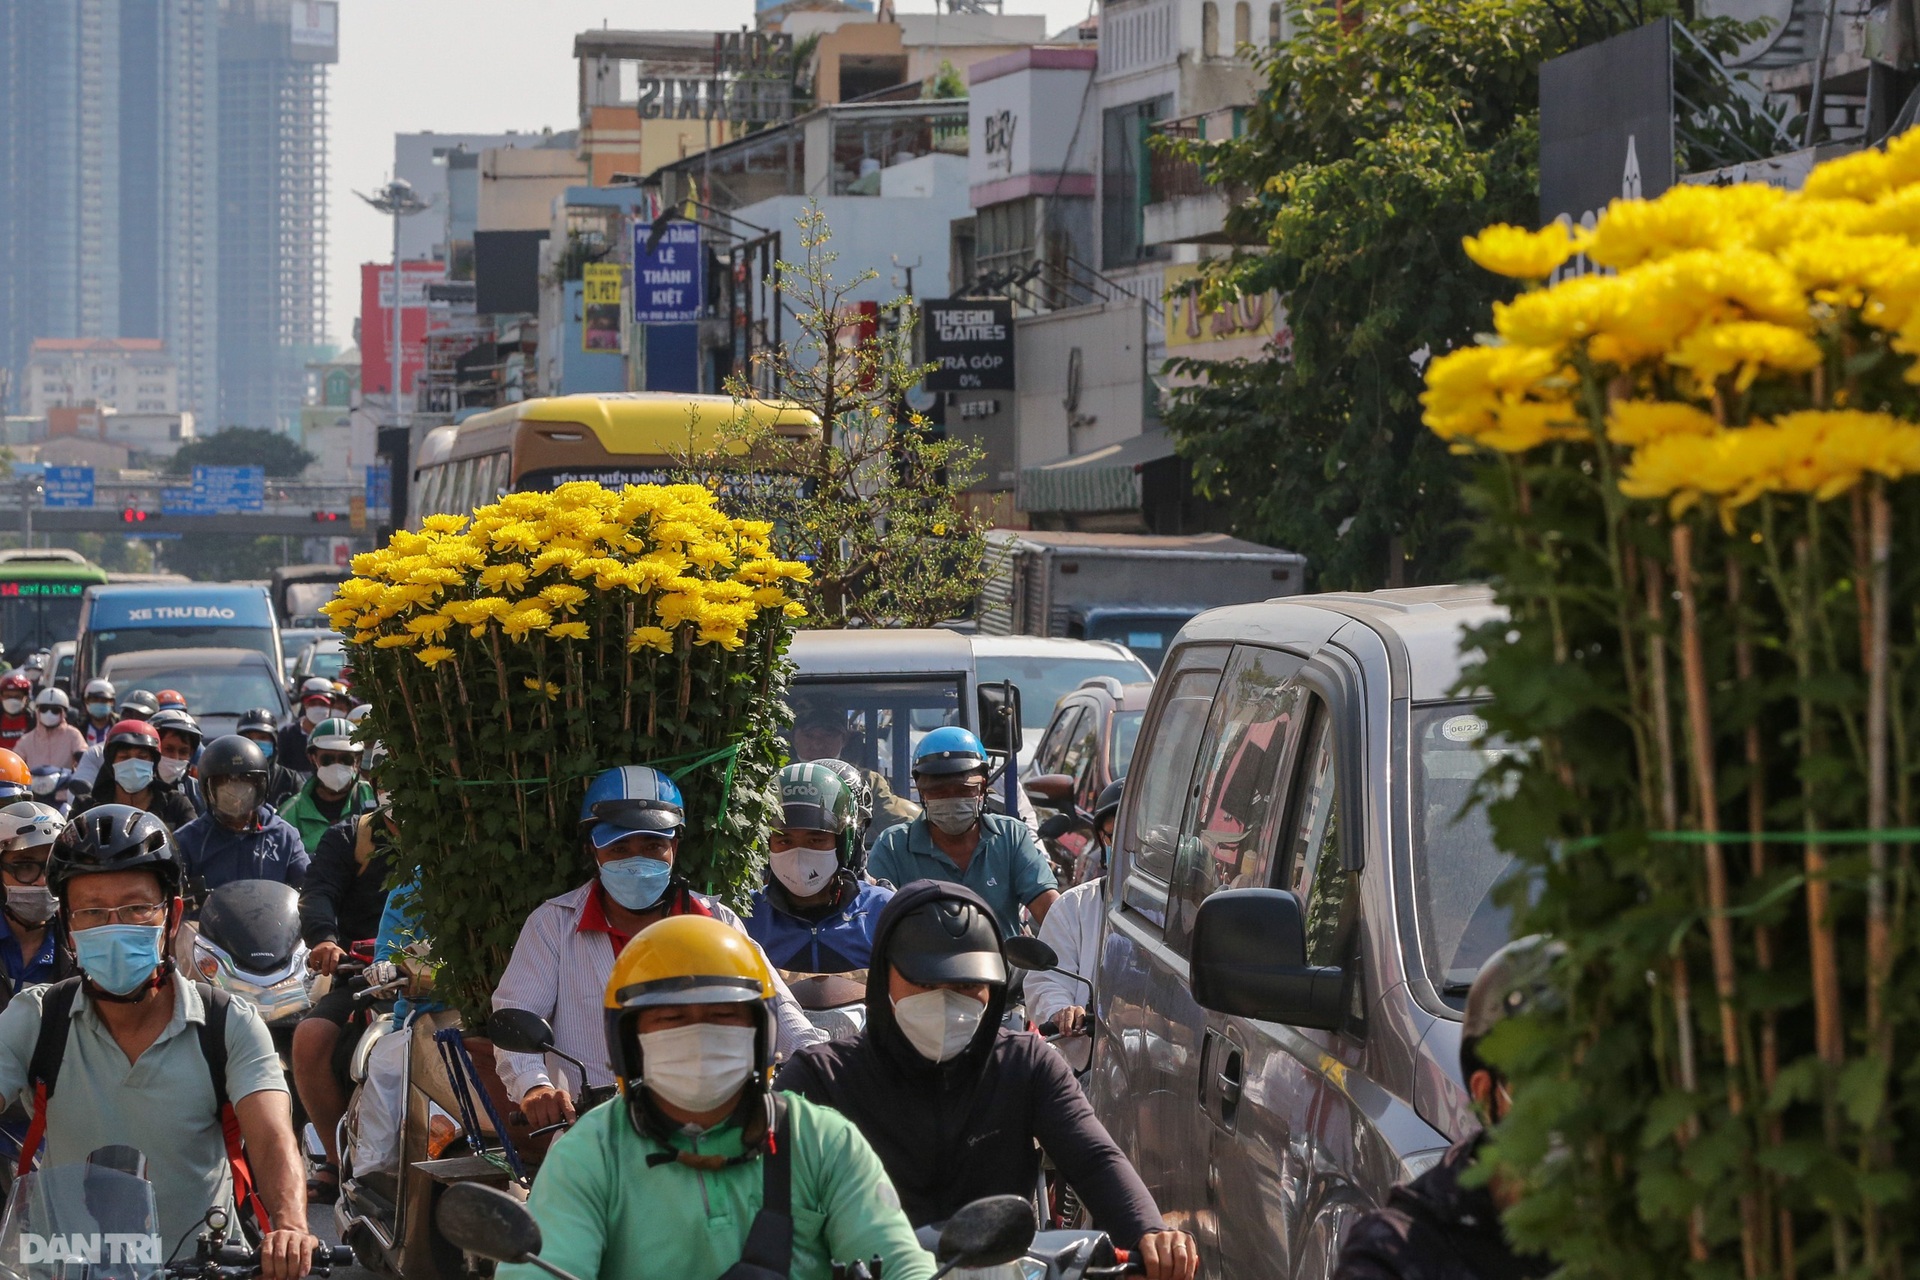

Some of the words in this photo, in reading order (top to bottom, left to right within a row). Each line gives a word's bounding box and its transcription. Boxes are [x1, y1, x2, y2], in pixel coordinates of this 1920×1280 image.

[658, 246, 675, 264] LÊ
[642, 268, 691, 285] THÀNH
[652, 287, 684, 307] KIỆT
[940, 324, 1006, 342] GAMES
[959, 374, 982, 388] 0%
[128, 608, 152, 620] XE
[1451, 724, 1478, 732] 06/22
[782, 783, 819, 796] Grab
